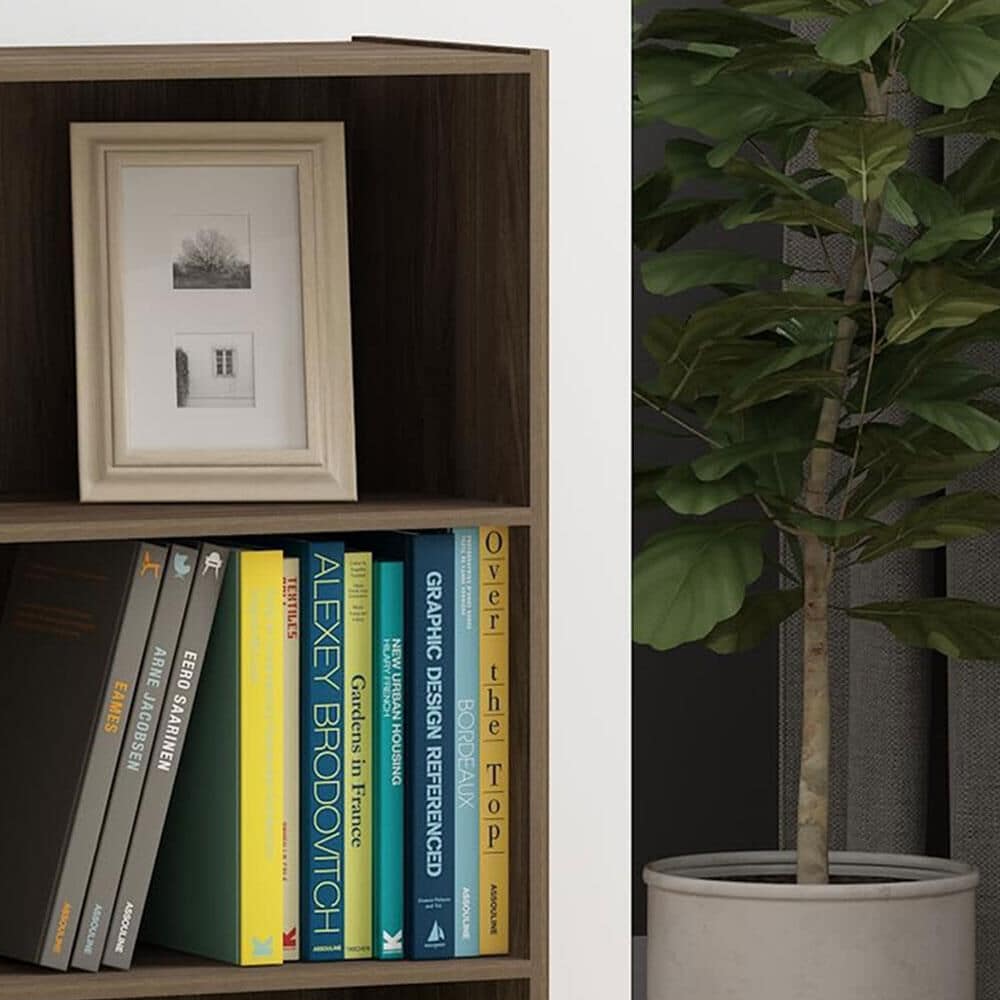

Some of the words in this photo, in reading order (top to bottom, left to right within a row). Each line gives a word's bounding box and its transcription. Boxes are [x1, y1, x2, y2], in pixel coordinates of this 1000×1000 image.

[426, 571, 442, 660] GRAPHIC
[485, 530, 503, 630] Over
[313, 553, 341, 691] ALEXEY
[392, 638, 402, 669] NEW
[147, 646, 167, 688] ARNE
[177, 650, 198, 689] EERO
[392, 673, 402, 720] URBAN
[488, 664, 500, 735] the
[104, 680, 128, 733] EAMES
[127, 692, 156, 771] JACOBSEN
[157, 694, 187, 771] SAARINEN
[351, 674, 366, 753] Gardens
[426, 667, 442, 739] DESIGN
[351, 759, 366, 777] in
[392, 724, 402, 785] HOUSING
[457, 700, 475, 809] BORDEAUX
[313, 703, 341, 933] BRODOVITCH
[351, 783, 366, 848] France
[426, 747, 442, 877] REFERENCED
[486, 763, 502, 848] Top
[115, 901, 134, 953] ASSOULINE
[489, 884, 498, 935] ASSOULINE
